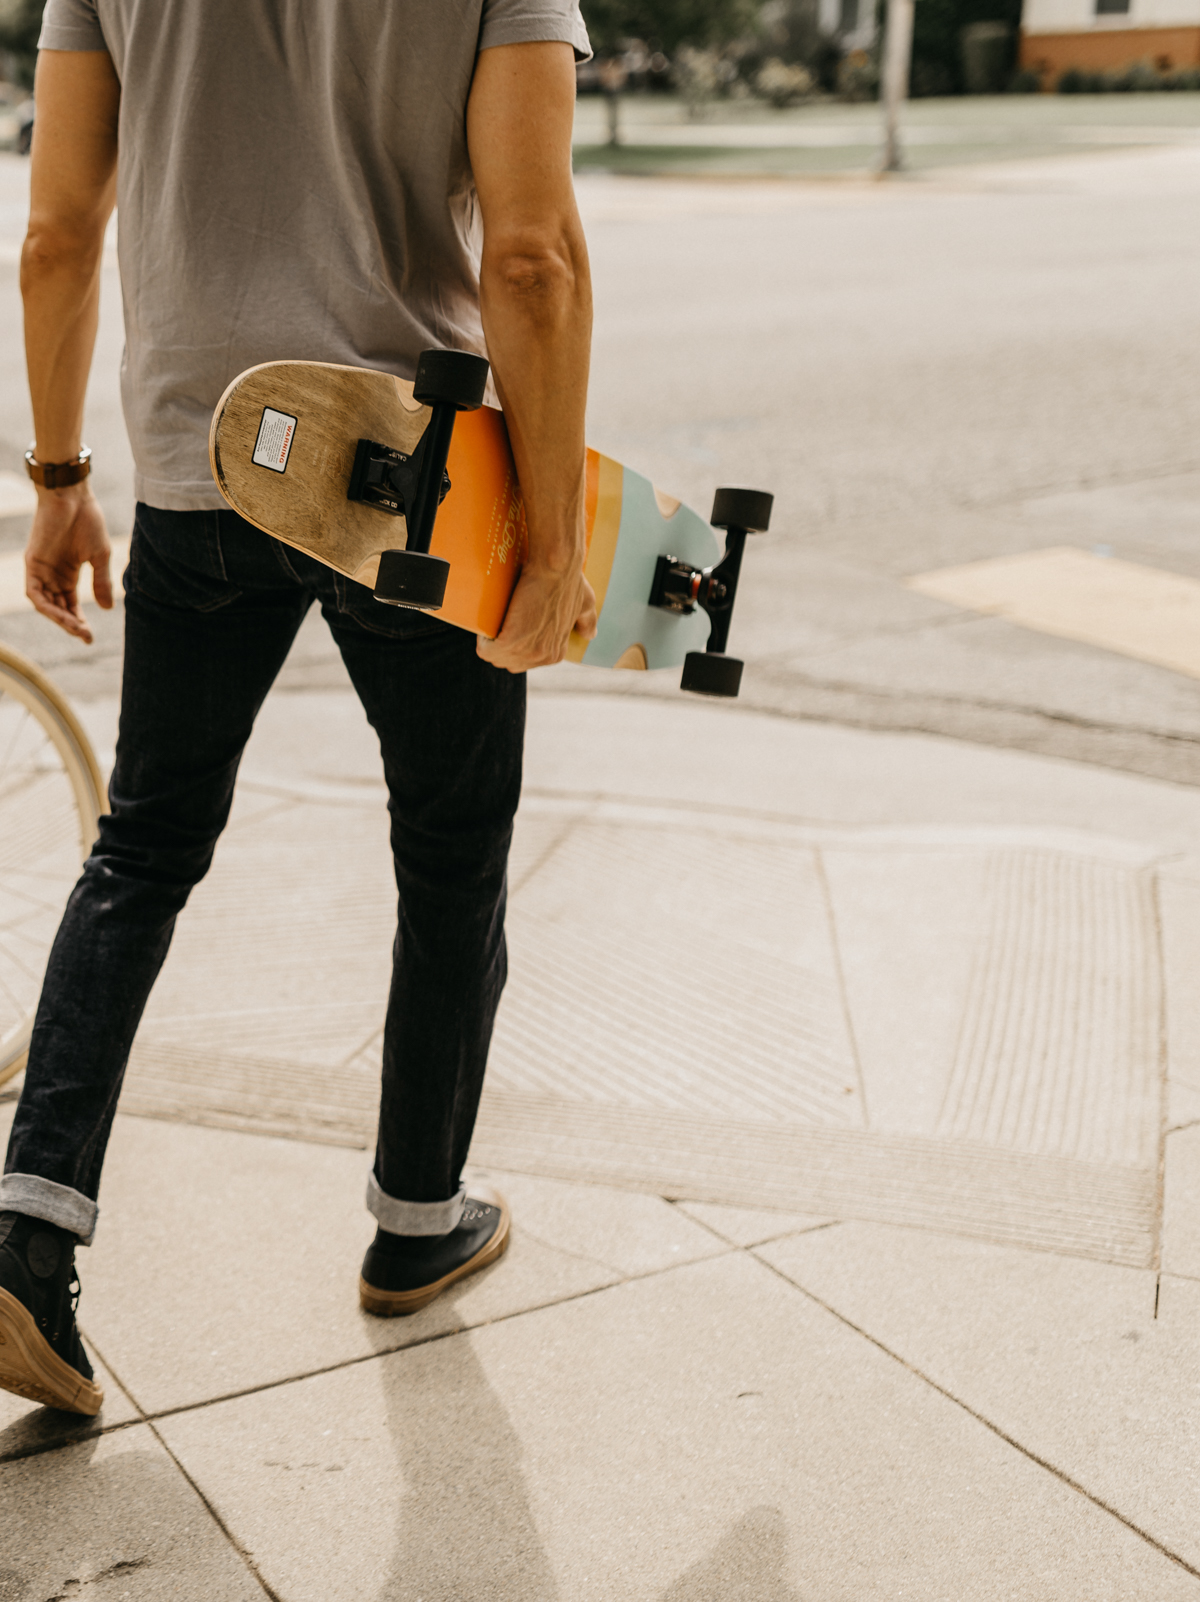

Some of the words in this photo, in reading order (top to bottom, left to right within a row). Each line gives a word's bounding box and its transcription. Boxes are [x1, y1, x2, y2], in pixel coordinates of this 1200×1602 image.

[279, 425, 293, 464] WARNING
[508, 484, 522, 522] The
[497, 520, 516, 564] Bug
